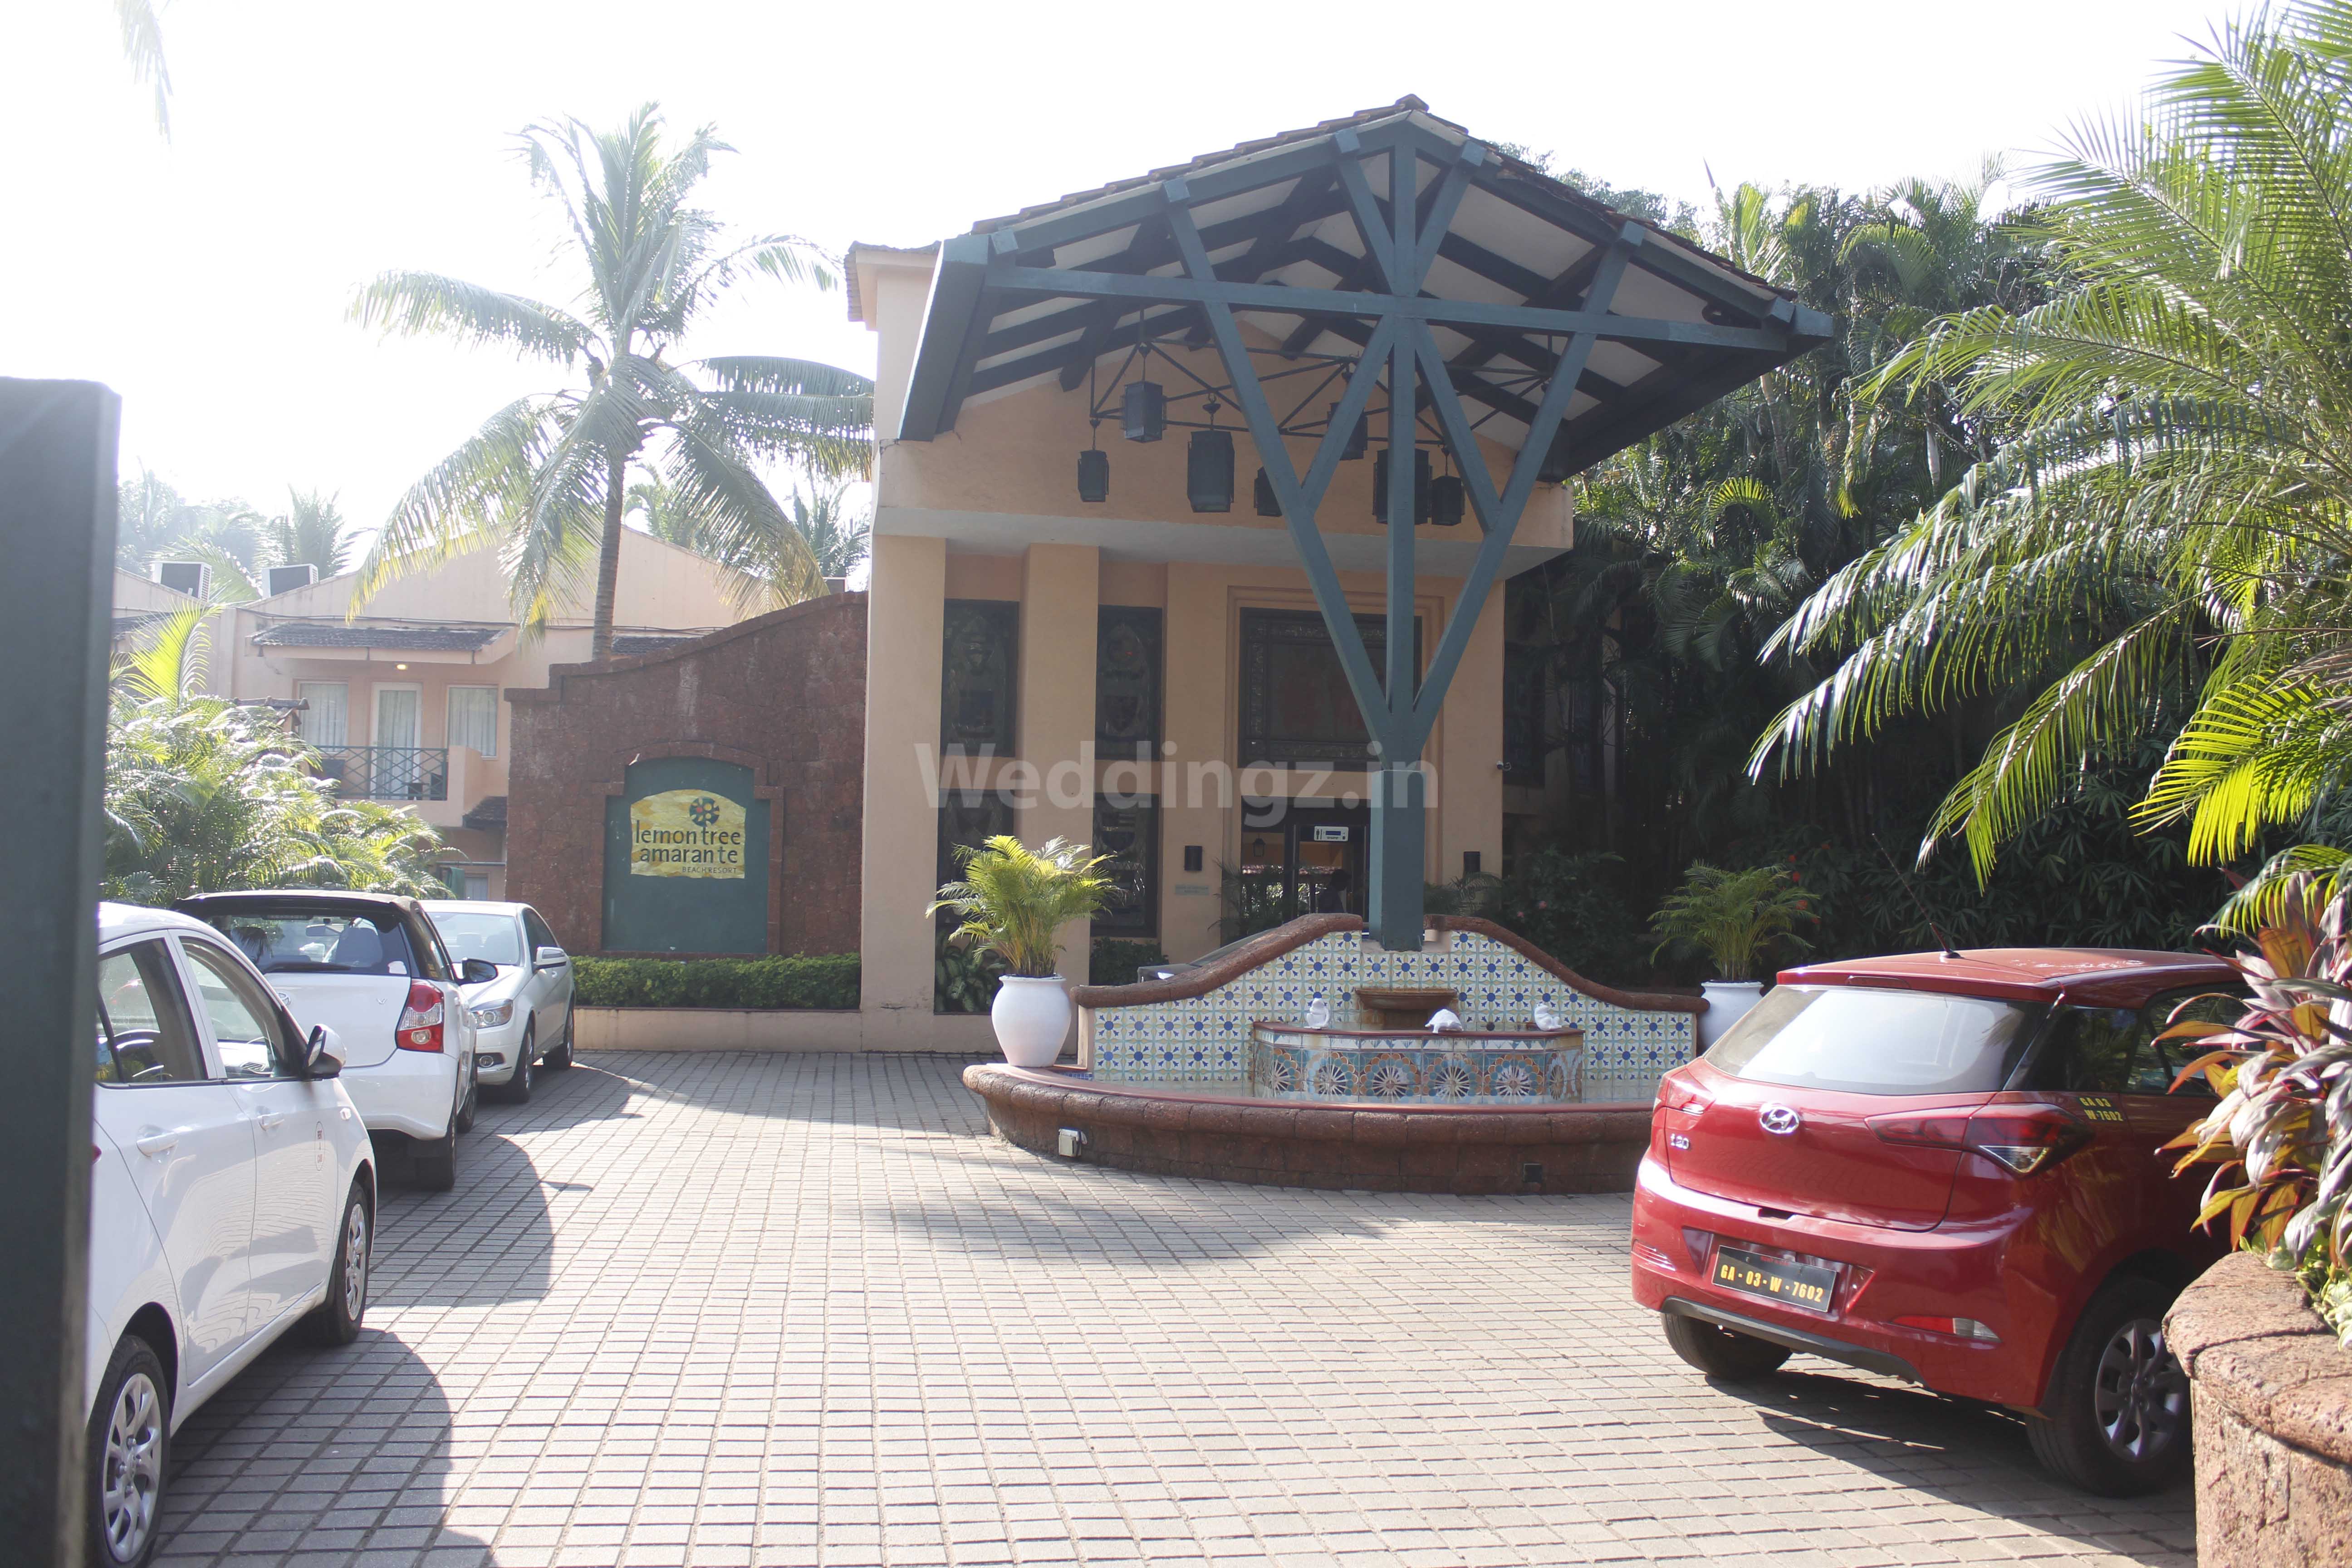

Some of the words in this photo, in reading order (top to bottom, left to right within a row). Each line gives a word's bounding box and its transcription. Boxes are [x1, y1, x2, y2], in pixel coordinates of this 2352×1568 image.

[636, 820, 697, 844] lemon
[701, 827, 741, 845] tree
[640, 846, 738, 864] amarante
[2079, 1097, 2096, 1106] GA
[2095, 1098, 2112, 1107] 03
